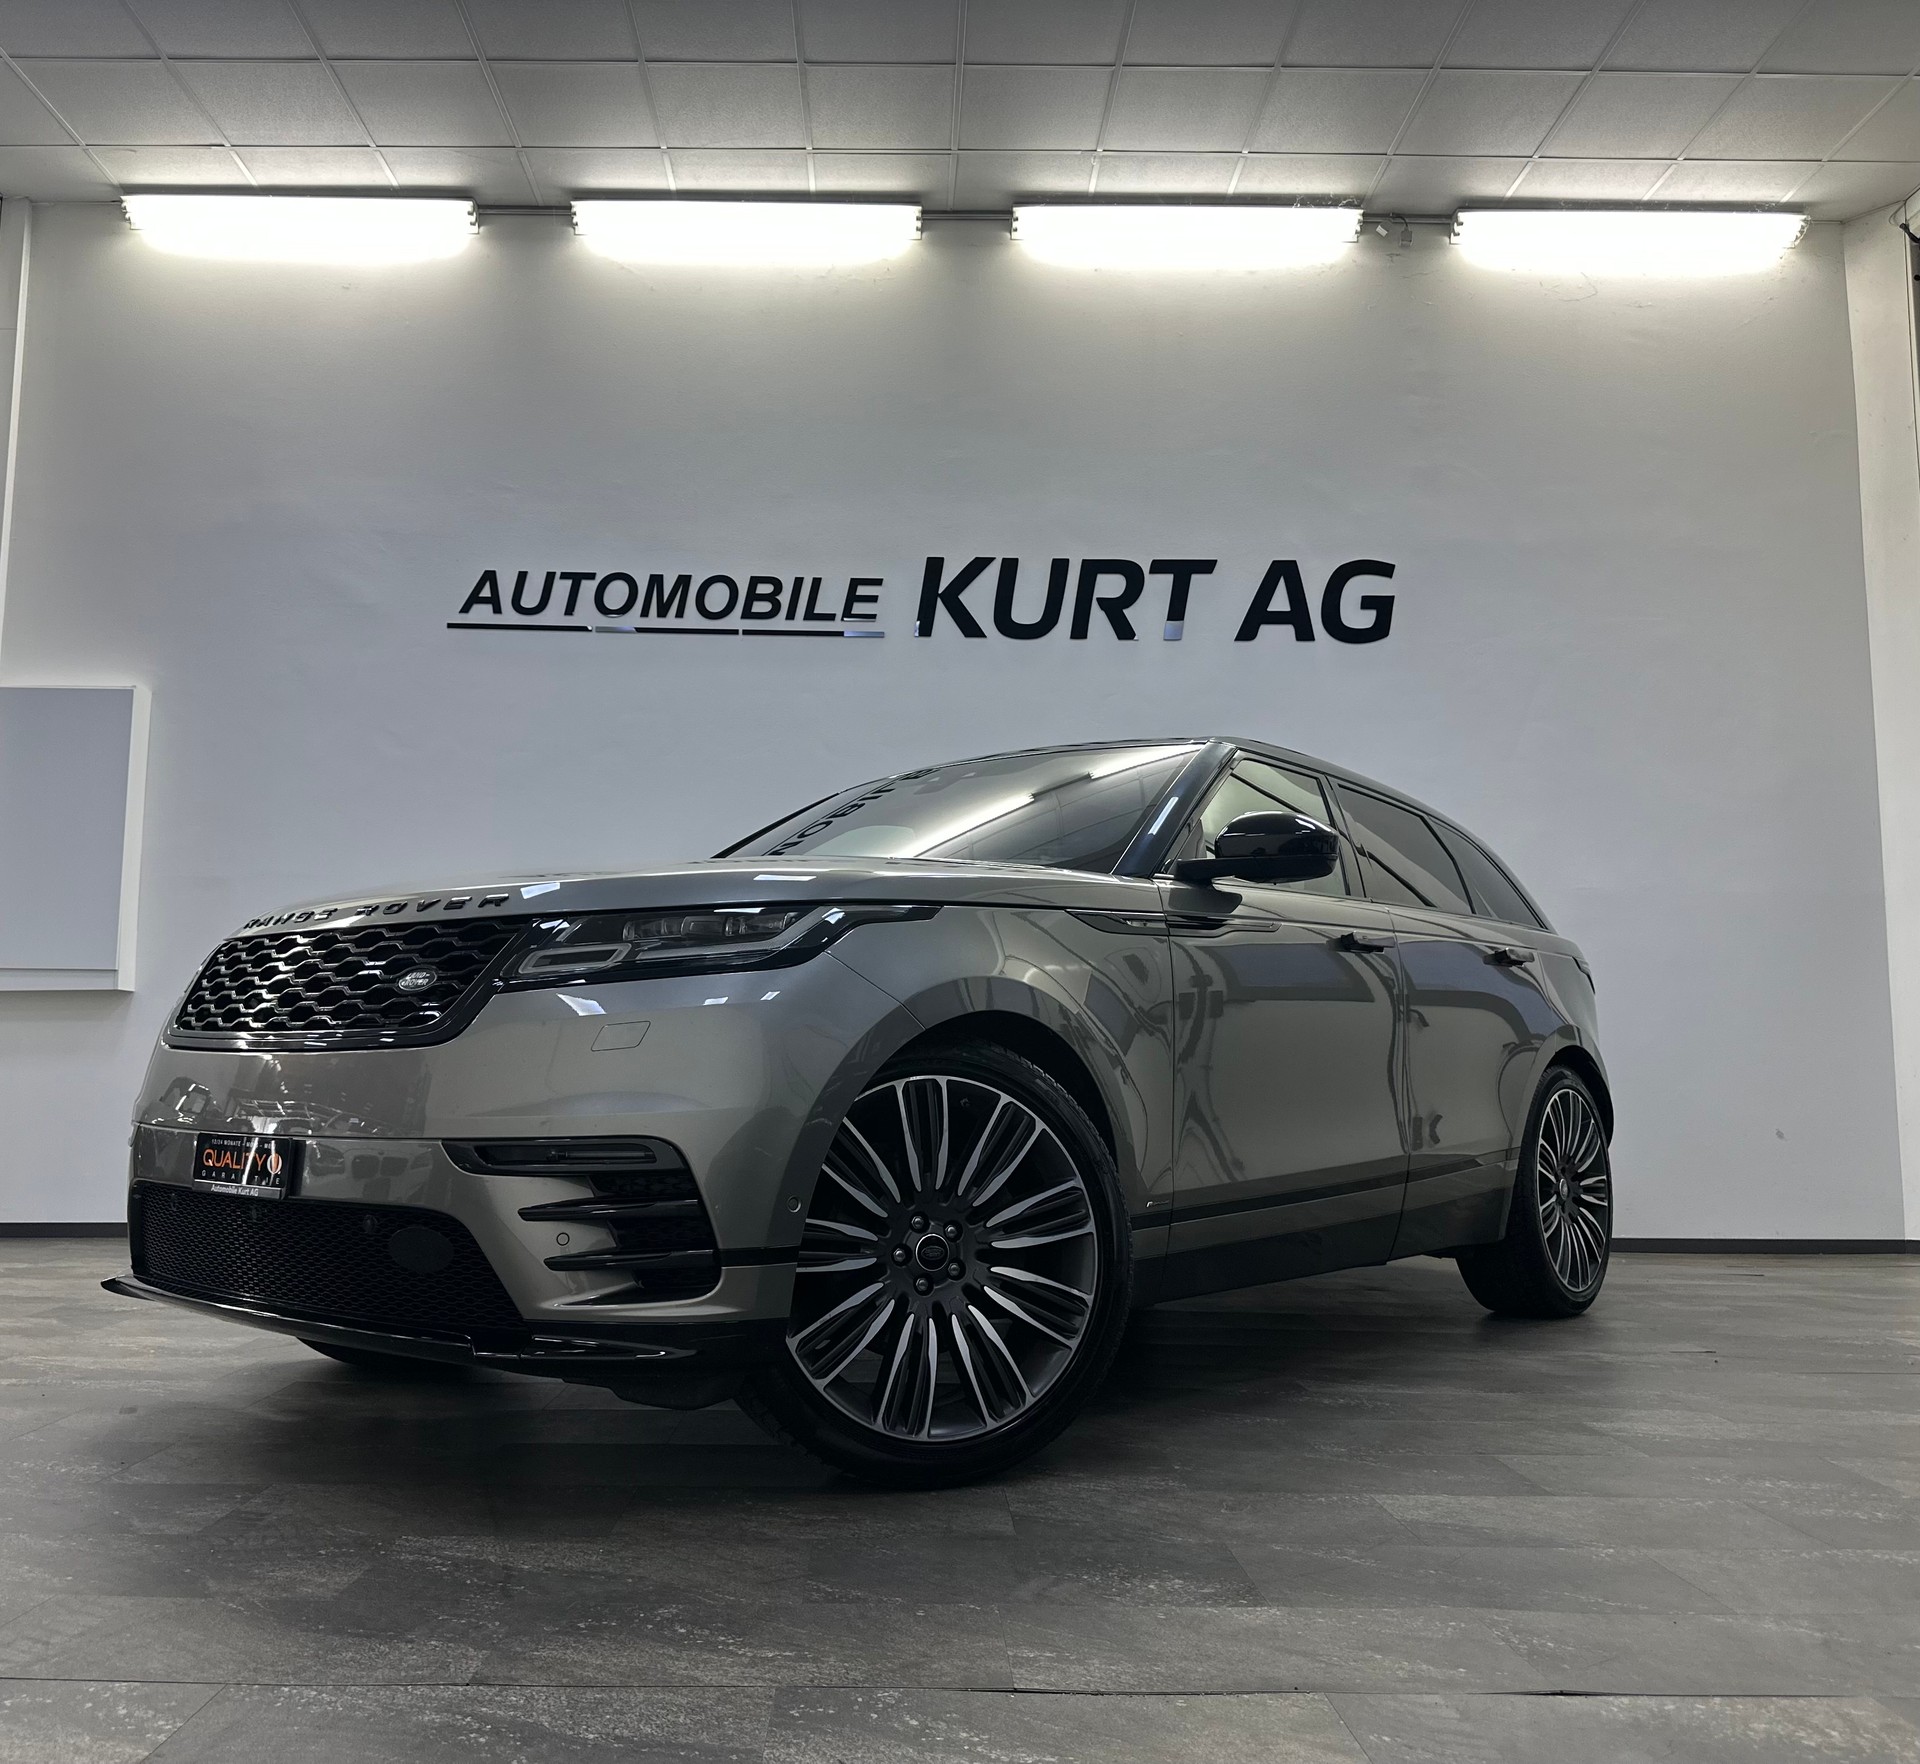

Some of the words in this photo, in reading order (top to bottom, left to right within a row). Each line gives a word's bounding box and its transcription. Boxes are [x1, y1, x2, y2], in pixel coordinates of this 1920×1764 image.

[459, 569, 884, 622] AUTOMOBILE
[914, 556, 1218, 641] KURT
[1234, 559, 1396, 644] AG
[355, 893, 509, 916] ROVER
[201, 1169, 280, 1185] GARATIE
[210, 1183, 238, 1195] Automobile
[237, 1186, 250, 1195] Kurt
[250, 1188, 259, 1197] AG
